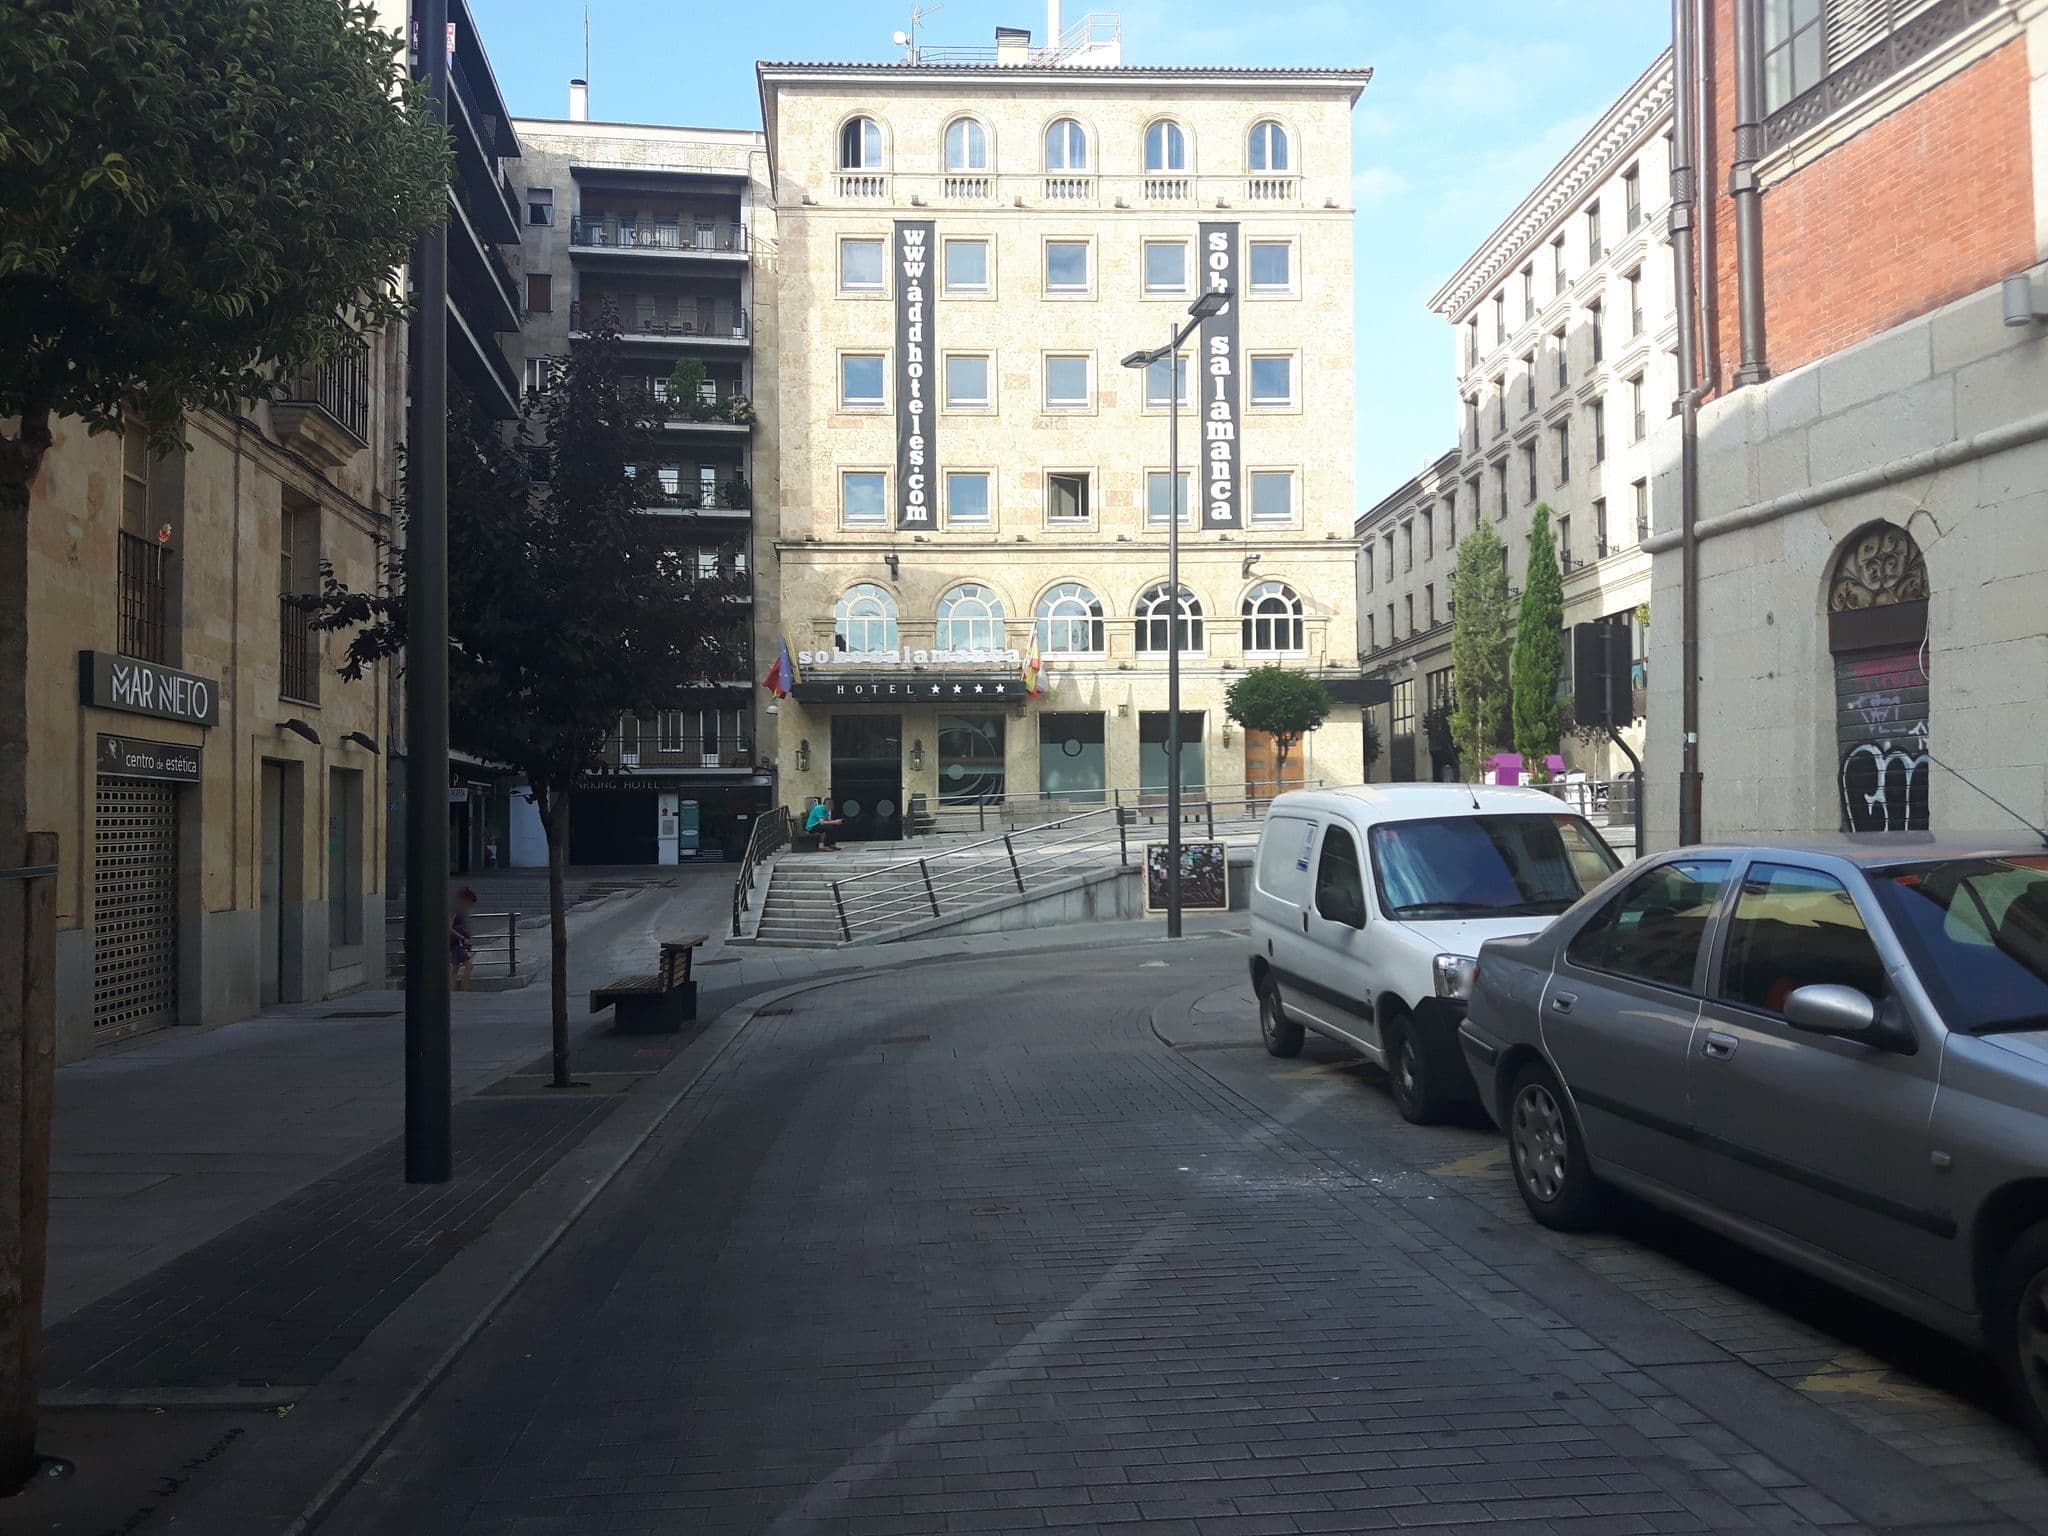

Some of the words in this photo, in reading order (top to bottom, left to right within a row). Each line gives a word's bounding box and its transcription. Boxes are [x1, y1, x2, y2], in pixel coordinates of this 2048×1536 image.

[902, 229, 928, 521] www.addhoteles.com
[1206, 336, 1235, 520] salamanca
[112, 663, 153, 709] MAR
[159, 674, 208, 718] NIETO
[837, 684, 914, 695] HOTEL
[125, 753, 155, 769] centro
[156, 760, 165, 770] de
[165, 755, 197, 773] estética
[577, 779, 617, 789] ARKING
[623, 779, 659, 789] HOTEL
